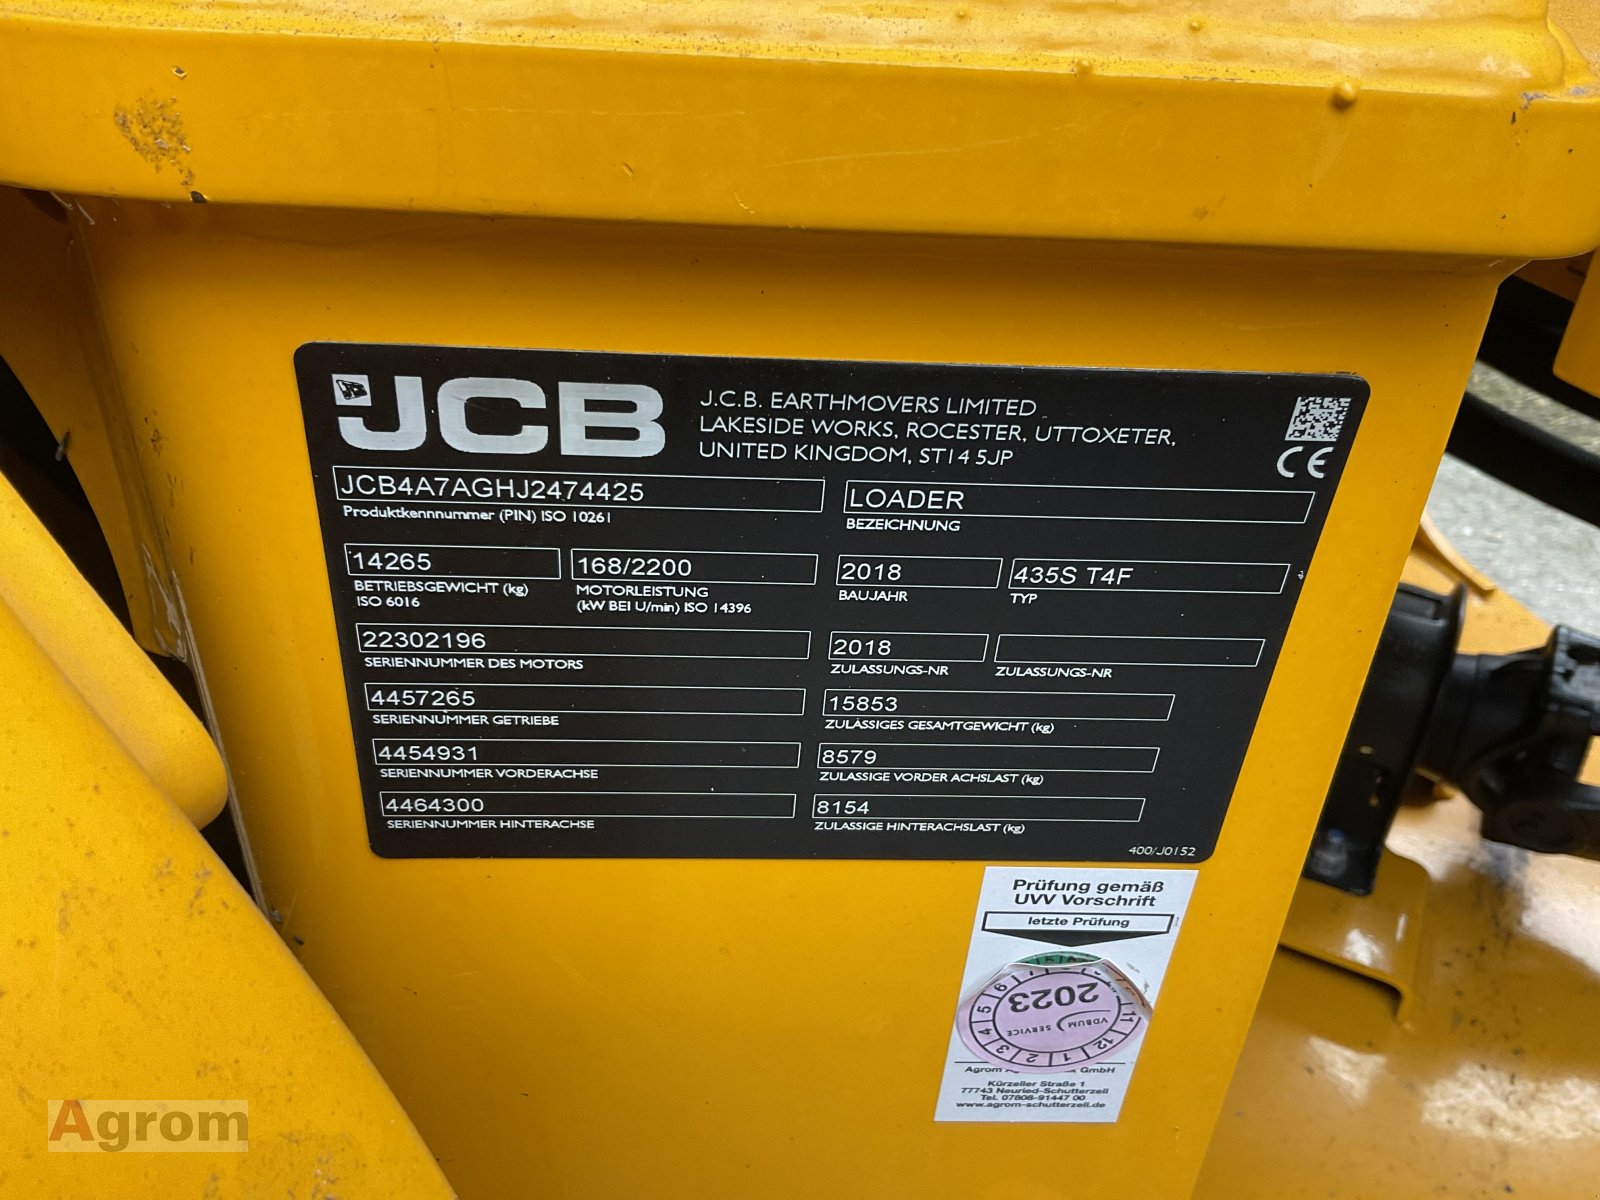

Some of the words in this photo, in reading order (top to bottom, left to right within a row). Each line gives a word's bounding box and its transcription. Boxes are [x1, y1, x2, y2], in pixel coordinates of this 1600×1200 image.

[700, 389, 763, 408] J.C.B.
[772, 392, 940, 414] EARTHMOVERS
[946, 397, 1037, 417] LIMITED
[333, 374, 666, 458] JCB
[700, 415, 804, 435] LAKESIDE
[811, 419, 899, 440] WORKS,
[906, 421, 1027, 443] ROCESTER,
[1035, 425, 1176, 446] UTTOXETER,
[699, 441, 787, 460] UNITED
[794, 444, 912, 465] KINGDOM,
[919, 447, 970, 465] ST14
[975, 449, 1014, 466] 5JP
[340, 474, 645, 502] JCB4A7AGHJ2474425
[849, 488, 964, 510] LOADER
[342, 504, 496, 521] Produktkennnummer
[498, 508, 537, 524] (PIN)
[541, 510, 567, 523] ISO
[573, 510, 611, 523] 10261
[845, 518, 961, 532] BEZEICHNUNG
[353, 552, 432, 571] 14265
[578, 557, 692, 577] 168/2200
[841, 563, 902, 581] 2018
[1013, 566, 1078, 584] 435S
[1086, 567, 1134, 585] T4F
[353, 580, 500, 594] BETRIEBSGEWICHT
[502, 582, 529, 597] (kg)
[576, 584, 709, 598] MOTORLEISTUNG
[838, 589, 909, 602] BAUJAHR
[356, 595, 383, 607] ISO
[385, 596, 421, 608] 6016
[1010, 592, 1038, 605] TYP
[576, 600, 605, 614] (kW
[608, 600, 631, 612] BEI
[635, 600, 681, 615] U/min)
[683, 601, 708, 613] ISO
[713, 602, 752, 614] 14396
[362, 631, 486, 649] 22302196
[832, 639, 892, 656] 2018
[364, 657, 485, 669] SERIENNUMMER
[488, 658, 517, 669] DES
[519, 658, 584, 670] MOTORS
[830, 664, 949, 676] ZULASSUNGS-NR
[994, 666, 1113, 678] ZULASSUNGS-NR
[370, 689, 476, 707] 4457265
[829, 696, 898, 712] 15853
[372, 714, 489, 725] SERIENNUMMER
[492, 715, 560, 726] GETRIEBE
[907, 720, 1030, 732] GESAMTGEWICHT
[1030, 722, 1055, 735] (kg)
[378, 745, 477, 761] 4454931
[821, 749, 877, 765] 8579
[380, 768, 494, 778] SERIENNUMMER
[495, 768, 599, 779] VORDERACHSE
[819, 772, 891, 782] ZULASSIGE
[893, 772, 949, 783] VORDER
[950, 773, 1019, 783] ACHSLAST
[1021, 773, 1044, 786] (kg)
[385, 797, 484, 813] 4464300
[816, 800, 870, 815] 8154
[386, 819, 498, 829] SERIENNUMMER
[499, 819, 595, 829] HINTERACHSE
[814, 822, 883, 831] ZULASSIGE
[885, 822, 1001, 832] HINTERACHSLAST
[1002, 823, 1026, 835] (kg)
[1128, 845, 1196, 857] 400/J0152
[1012, 879, 1091, 893] Prüfung
[1096, 881, 1165, 893] gemäß
[1014, 894, 1057, 905] UVV
[1062, 894, 1157, 907] Vorschrift
[1027, 916, 1069, 927] letzte
[1072, 917, 1130, 928] Prüfung
[994, 983, 1007, 991] 6
[1008, 981, 1099, 1013] 2023
[977, 1005, 992, 1014] 5
[1068, 1017, 1108, 1028] VDBUM
[1006, 1024, 1051, 1036] SERVICE
[996, 1044, 1010, 1054] 3
[1092, 1037, 1114, 1050] 12
[1025, 1053, 1040, 1063] 2
[1063, 1052, 1072, 1062] 1
